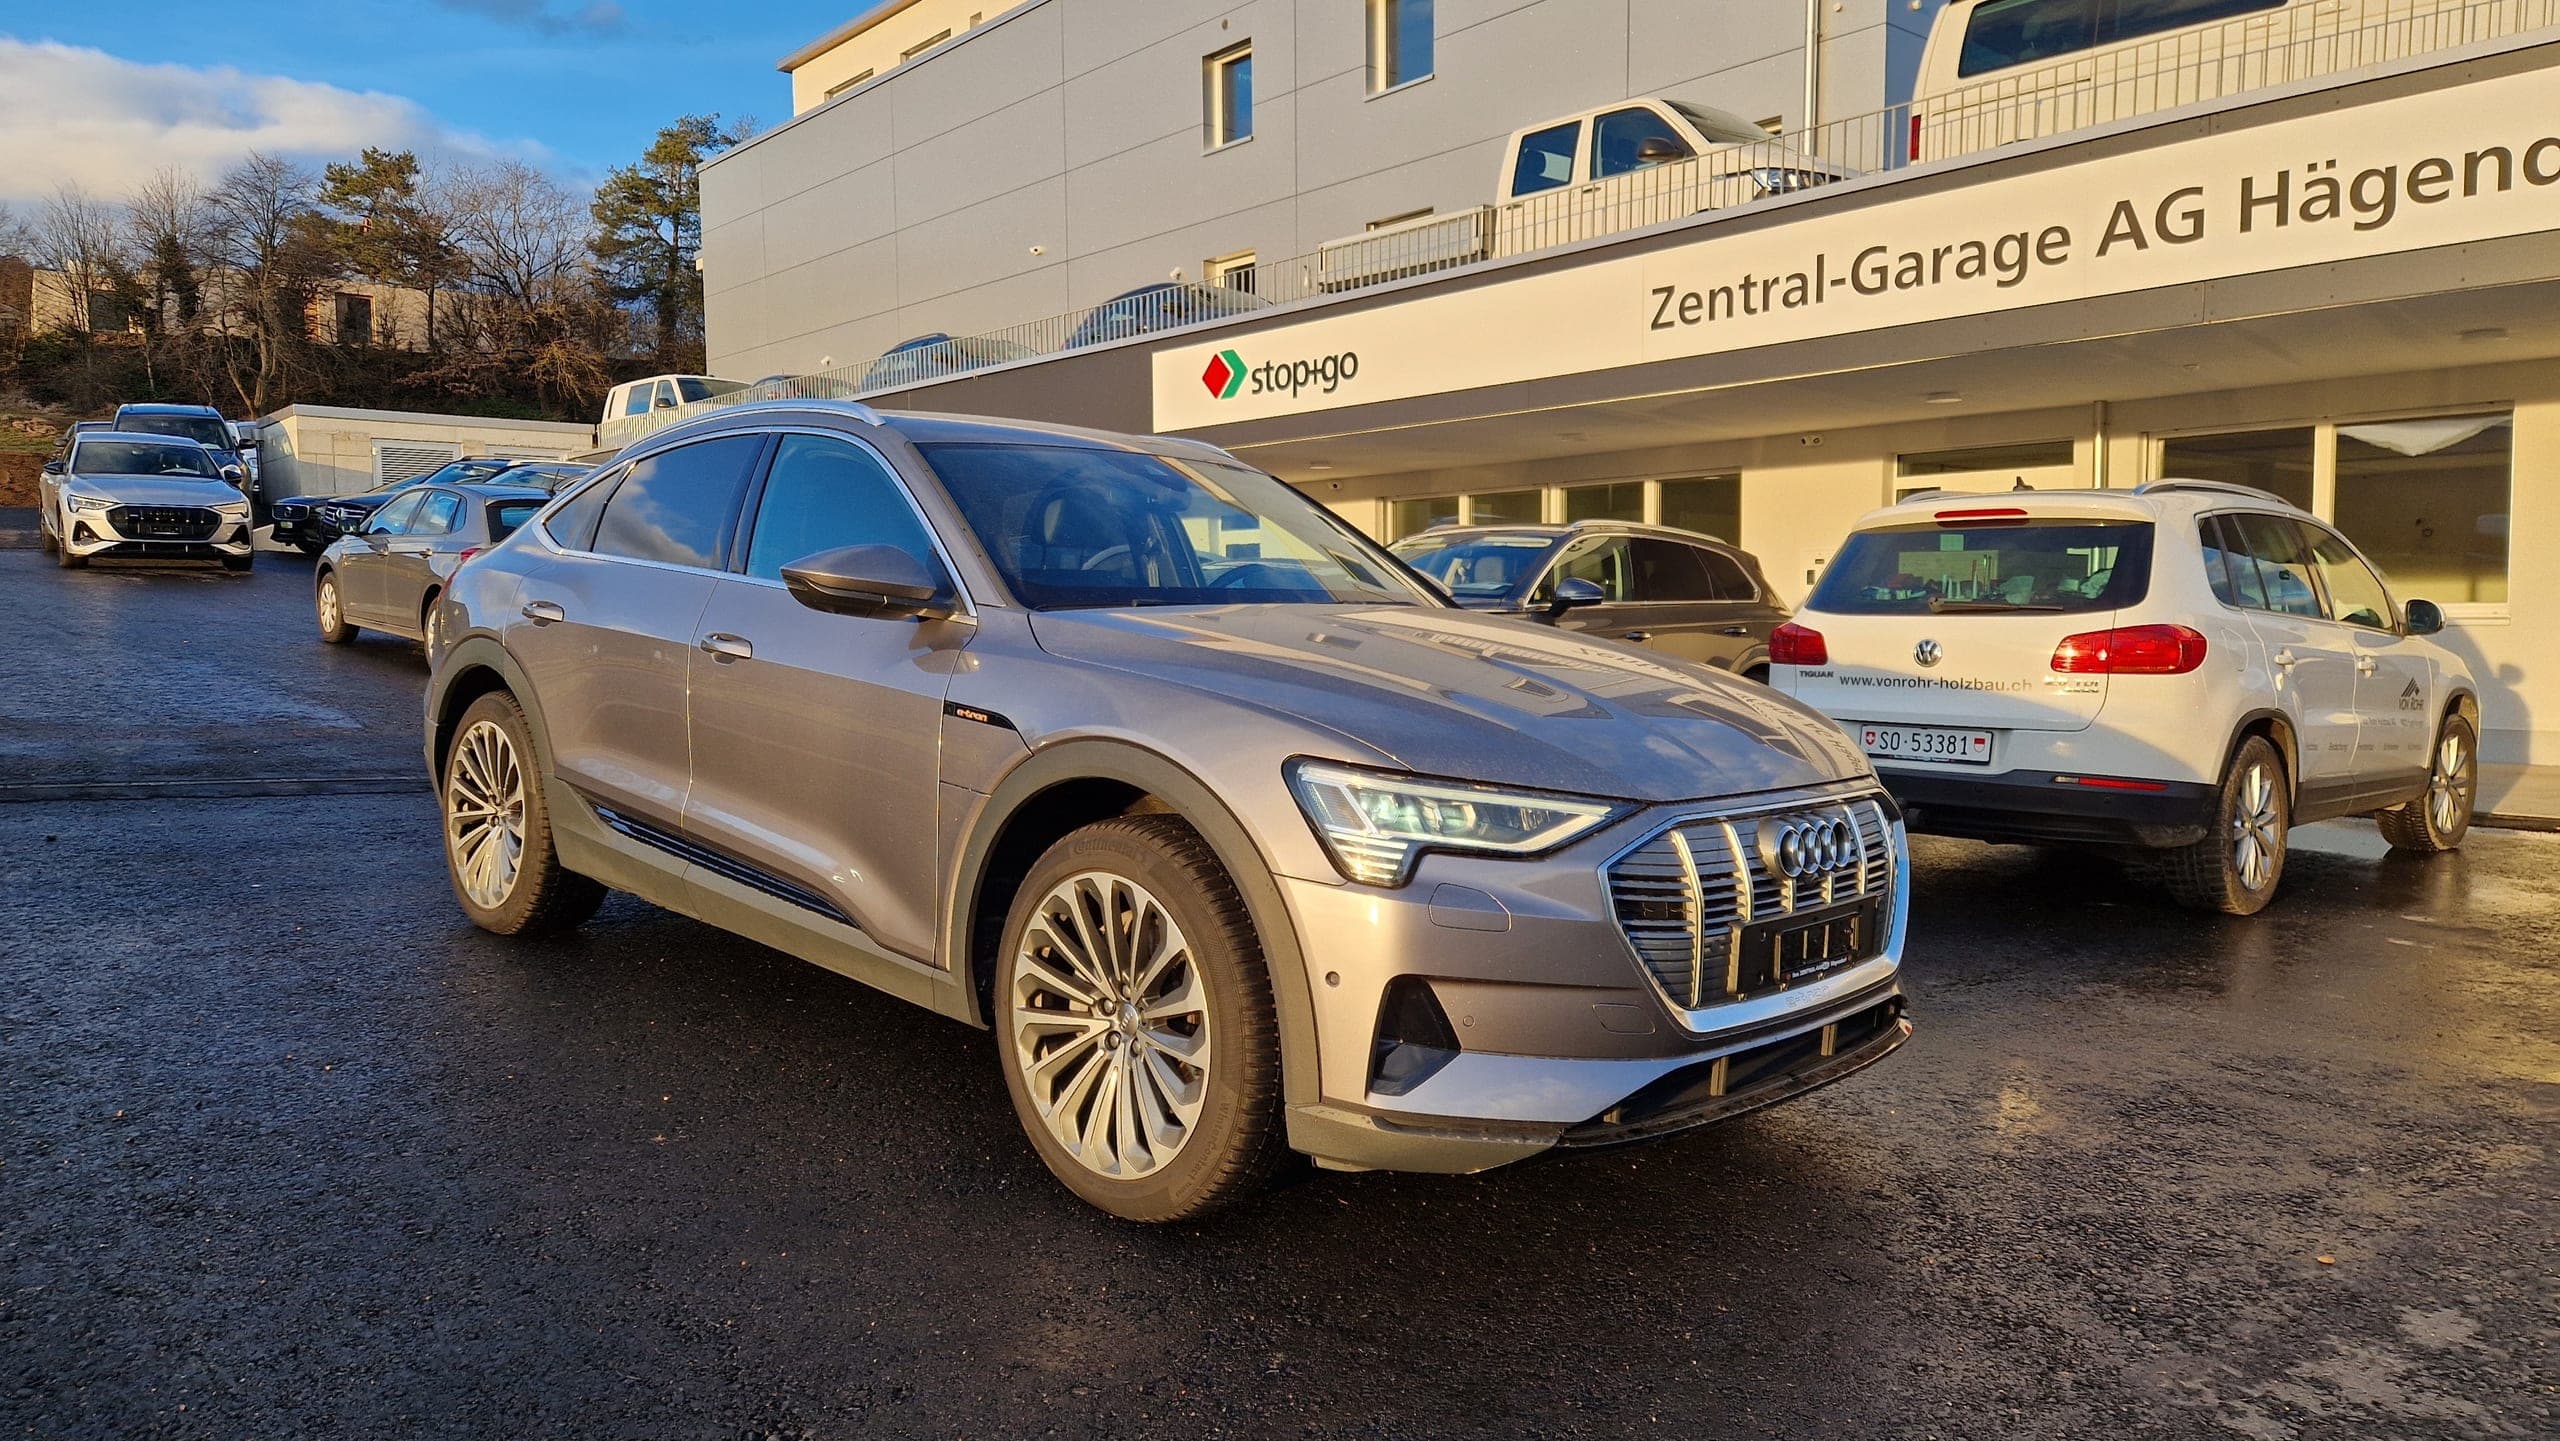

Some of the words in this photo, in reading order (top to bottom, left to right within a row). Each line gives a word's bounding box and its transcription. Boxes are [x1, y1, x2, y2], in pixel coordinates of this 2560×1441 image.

[1650, 223, 2071, 331] Zentral-Garage
[2095, 186, 2205, 257] AG
[1251, 351, 1359, 398] stop+go
[1799, 669, 1834, 678] TIGUAN
[1839, 675, 2033, 692] www.vonrohr-holzbau.ch
